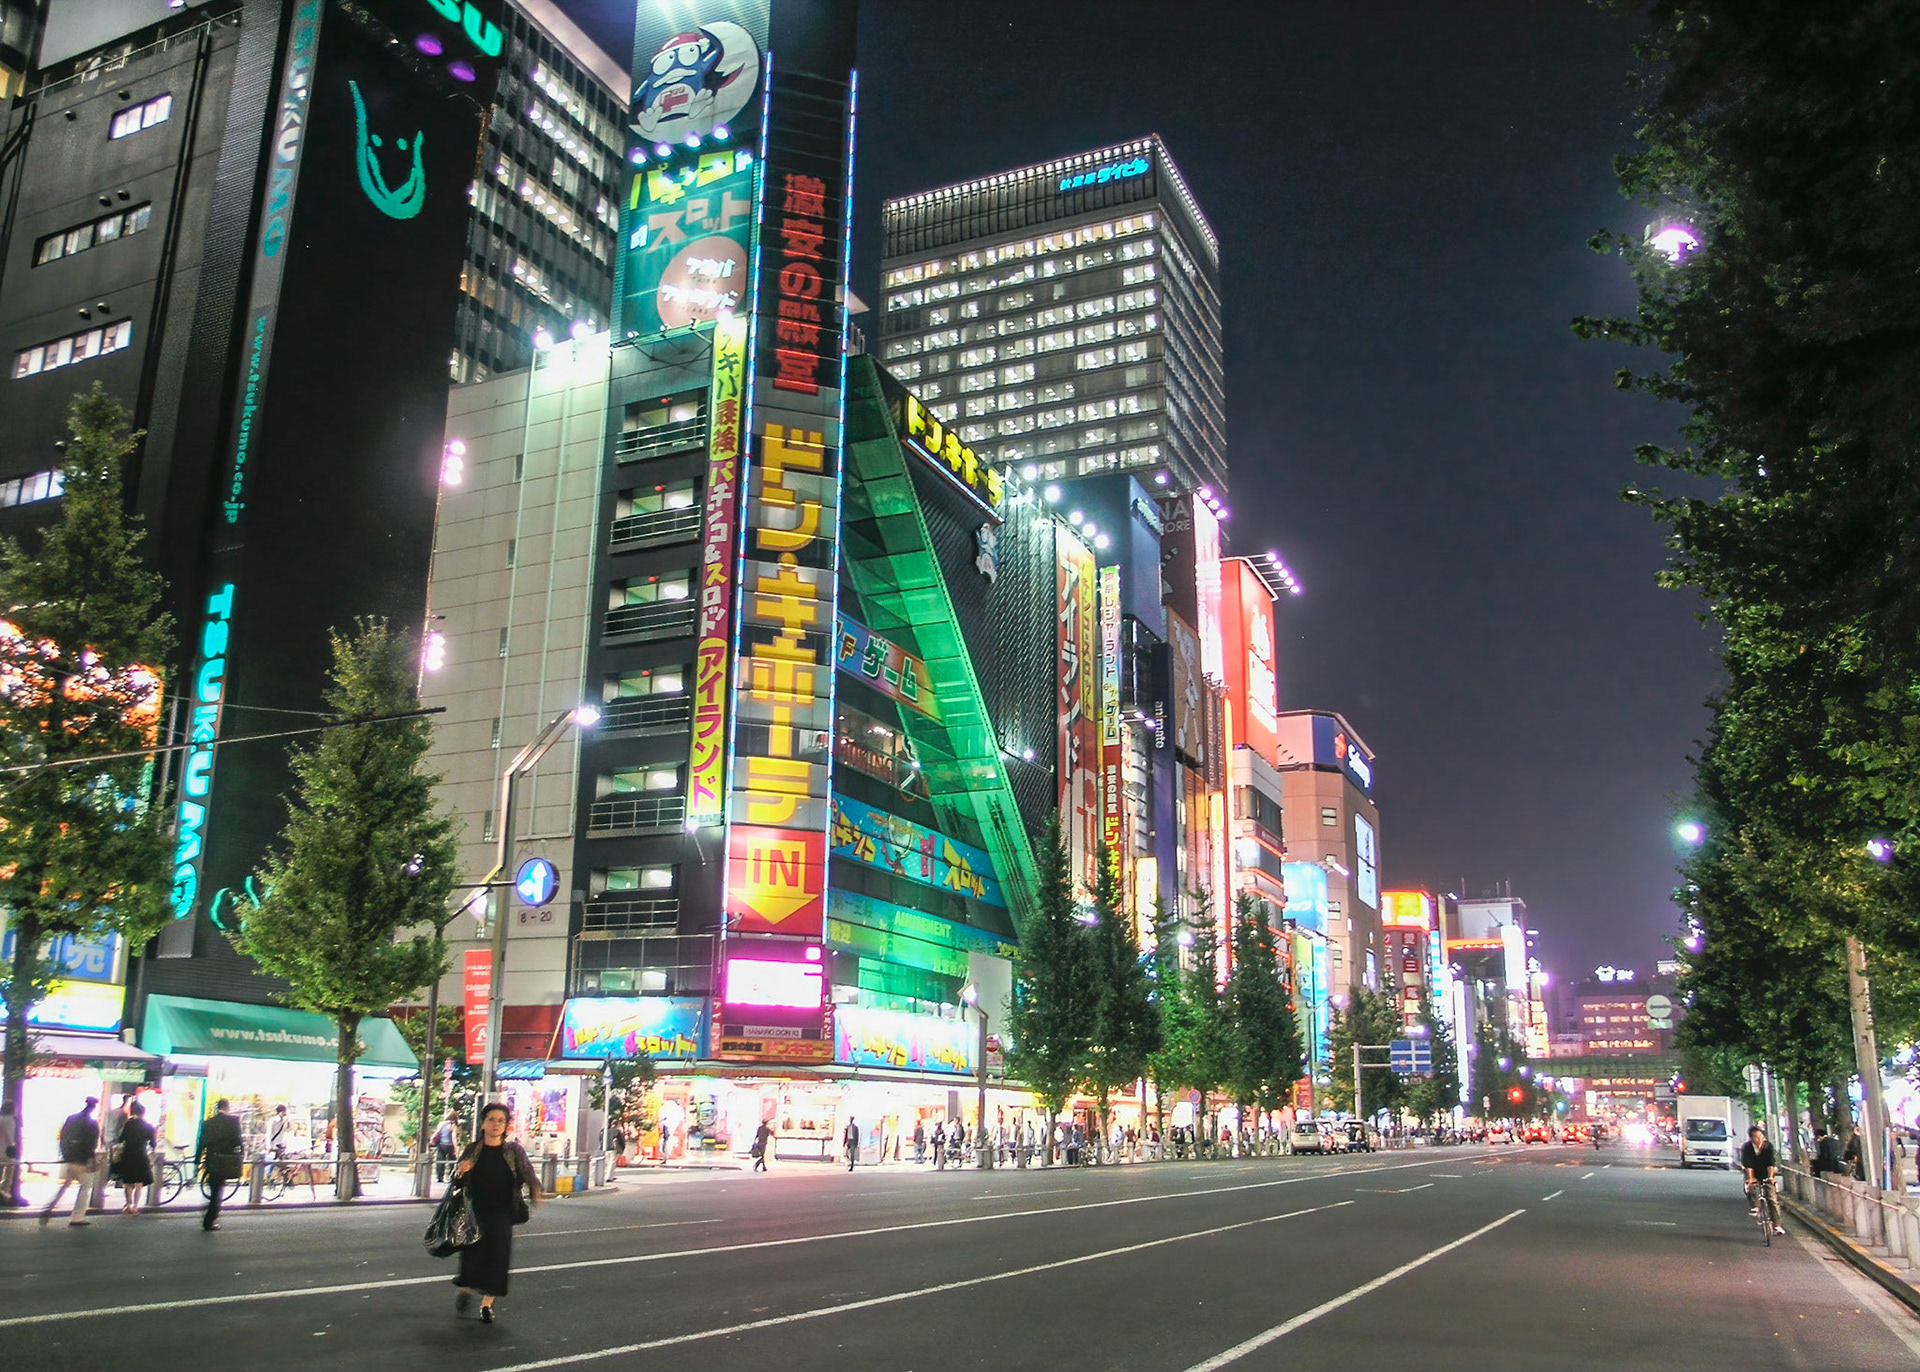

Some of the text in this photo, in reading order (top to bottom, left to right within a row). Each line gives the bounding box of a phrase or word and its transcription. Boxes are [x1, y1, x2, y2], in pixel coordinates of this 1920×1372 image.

[263, 0, 319, 258] TSUKUMO
[648, 191, 751, 253] スロット
[772, 173, 828, 396] 激安の殿堂
[223, 315, 267, 524] www.tsukumo.co.jp
[711, 333, 740, 455] アキバ最強
[746, 422, 824, 824] ドン・キホーテ
[861, 635, 918, 702] ゲーム
[174, 583, 235, 920] TSUKUMO
[692, 645, 724, 808] アイランド
[1155, 700, 1168, 749] animate
[1348, 743, 1372, 788] Sfp
[753, 848, 800, 888] IN
[210, 1026, 366, 1049] www.tsukumo.c
